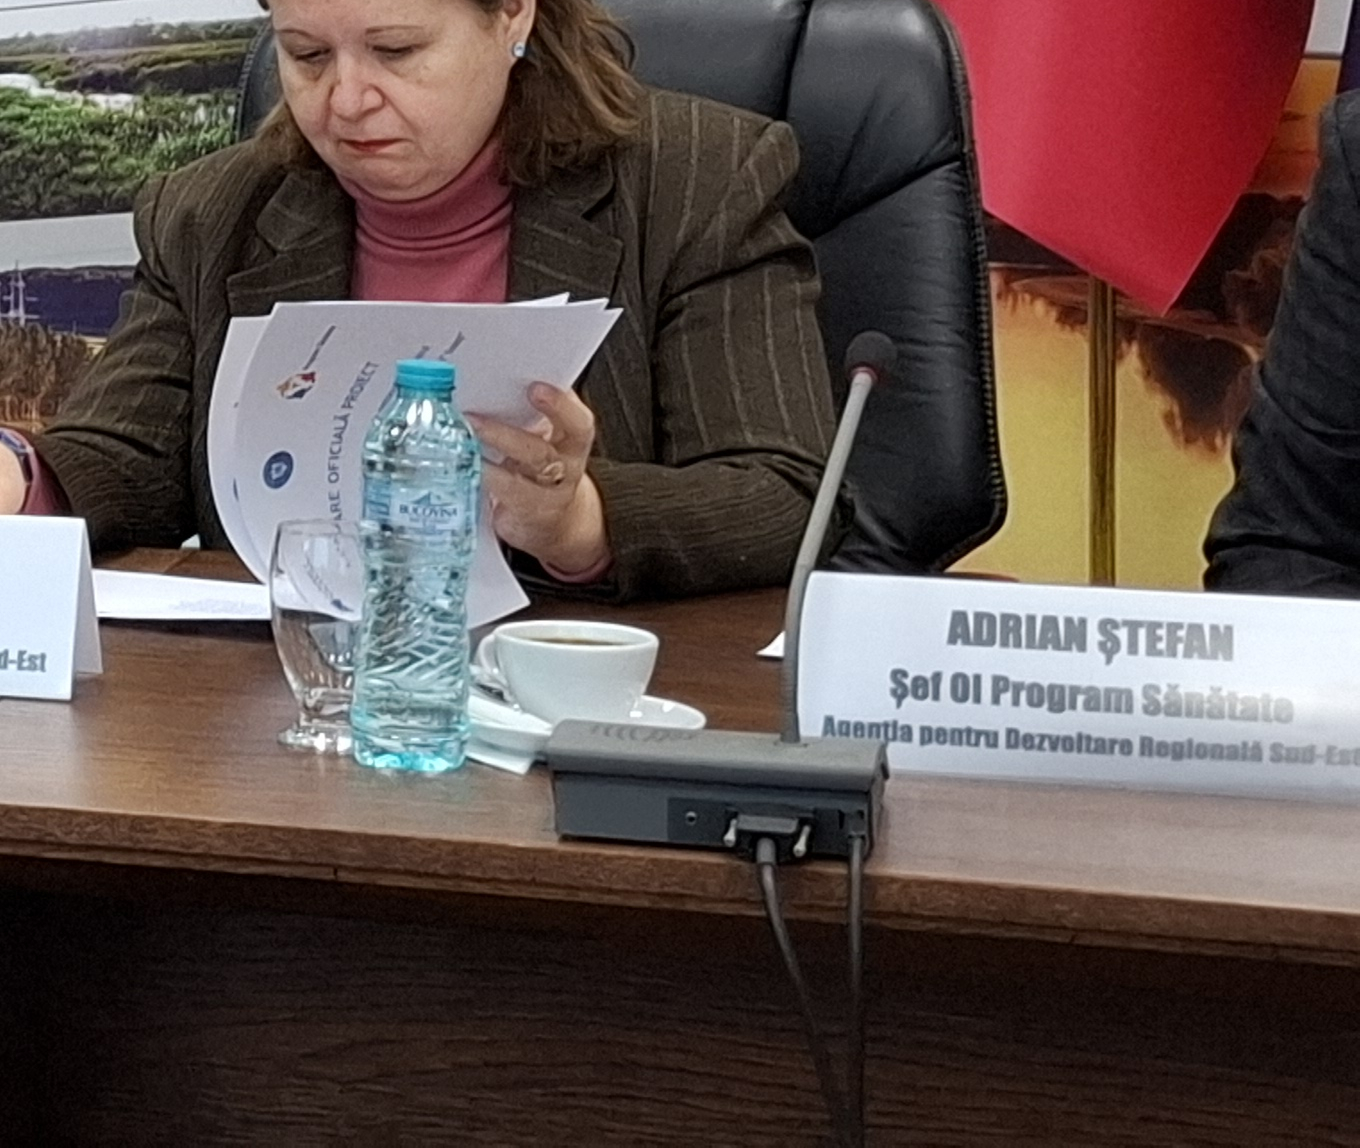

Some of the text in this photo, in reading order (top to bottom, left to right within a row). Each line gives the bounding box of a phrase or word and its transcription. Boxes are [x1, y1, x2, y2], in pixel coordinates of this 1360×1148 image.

[340, 360, 380, 410] PROIECT
[946, 609, 1235, 665] ADRIAN ȘTEFAN
[889, 668, 942, 710] Șef
[990, 674, 1134, 715] Program
[1141, 683, 1296, 725] Sănătate
[918, 723, 1000, 750] pentru
[1004, 727, 1134, 757] Dezvoltare
[1138, 735, 1264, 765] Regională
